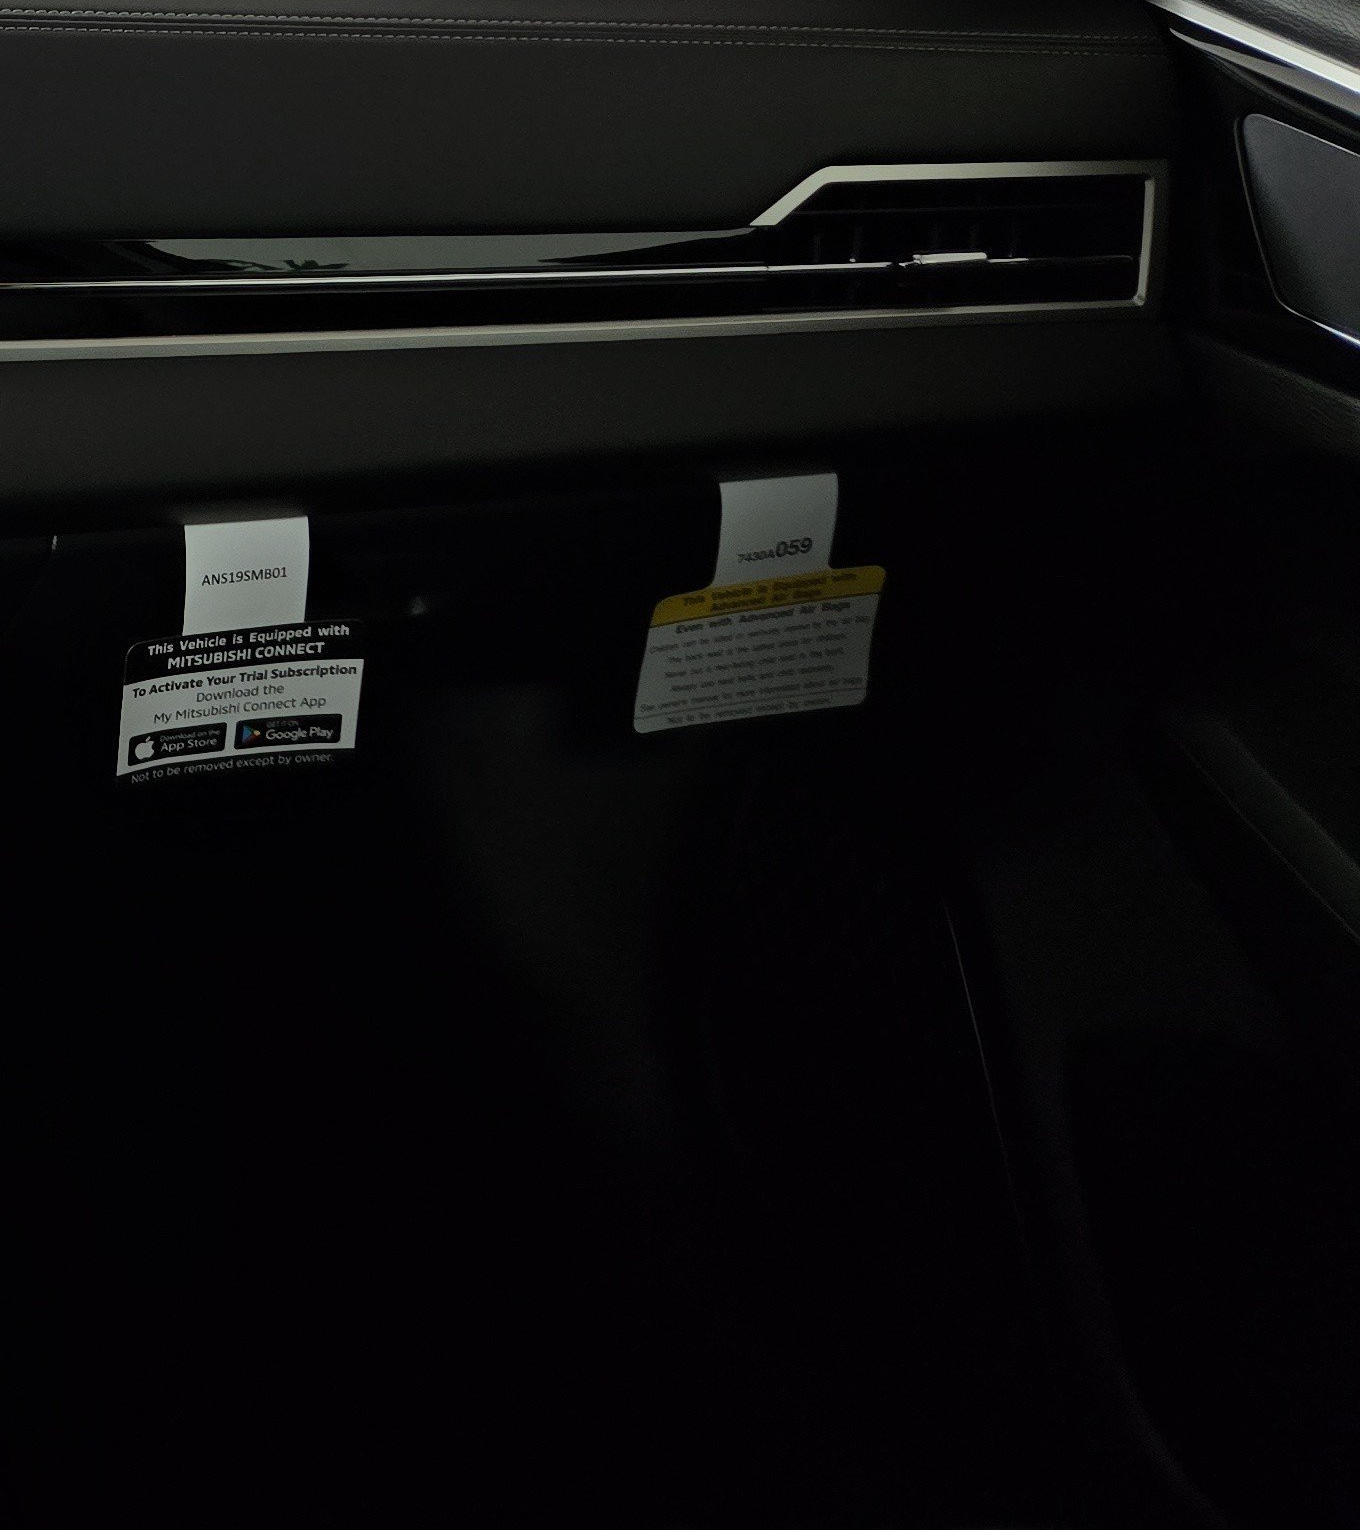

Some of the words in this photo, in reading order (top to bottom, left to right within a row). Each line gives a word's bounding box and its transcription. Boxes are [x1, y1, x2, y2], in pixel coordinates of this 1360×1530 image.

[201, 566, 288, 587] ANS19SMB01
[148, 642, 174, 656] This
[180, 635, 227, 652] Vehicle
[232, 633, 243, 645] is
[249, 626, 312, 645] Equipped
[318, 624, 350, 637] with
[167, 648, 252, 670] MITSUBISHI
[255, 641, 326, 659] CONNECT
[132, 686, 147, 699] To
[148, 677, 204, 696] Activate
[206, 673, 237, 688] Your
[239, 669, 269, 684] Trial
[270, 663, 358, 681] Subscription
[196, 685, 259, 703] Download
[263, 683, 285, 695] the
[153, 711, 173, 725] My
[175, 703, 241, 721] Mitsubishi
[243, 697, 297, 713] Connect
[300, 695, 327, 710] App
[160, 741, 185, 754] App
[187, 738, 218, 749] Store
[265, 727, 308, 742] Google
[309, 726, 334, 740] Play
[131, 773, 150, 785] Not
[152, 769, 164, 779] to
[166, 766, 180, 776] be
[183, 759, 234, 773] removed
[235, 755, 275, 768] except
[278, 753, 292, 766] by
